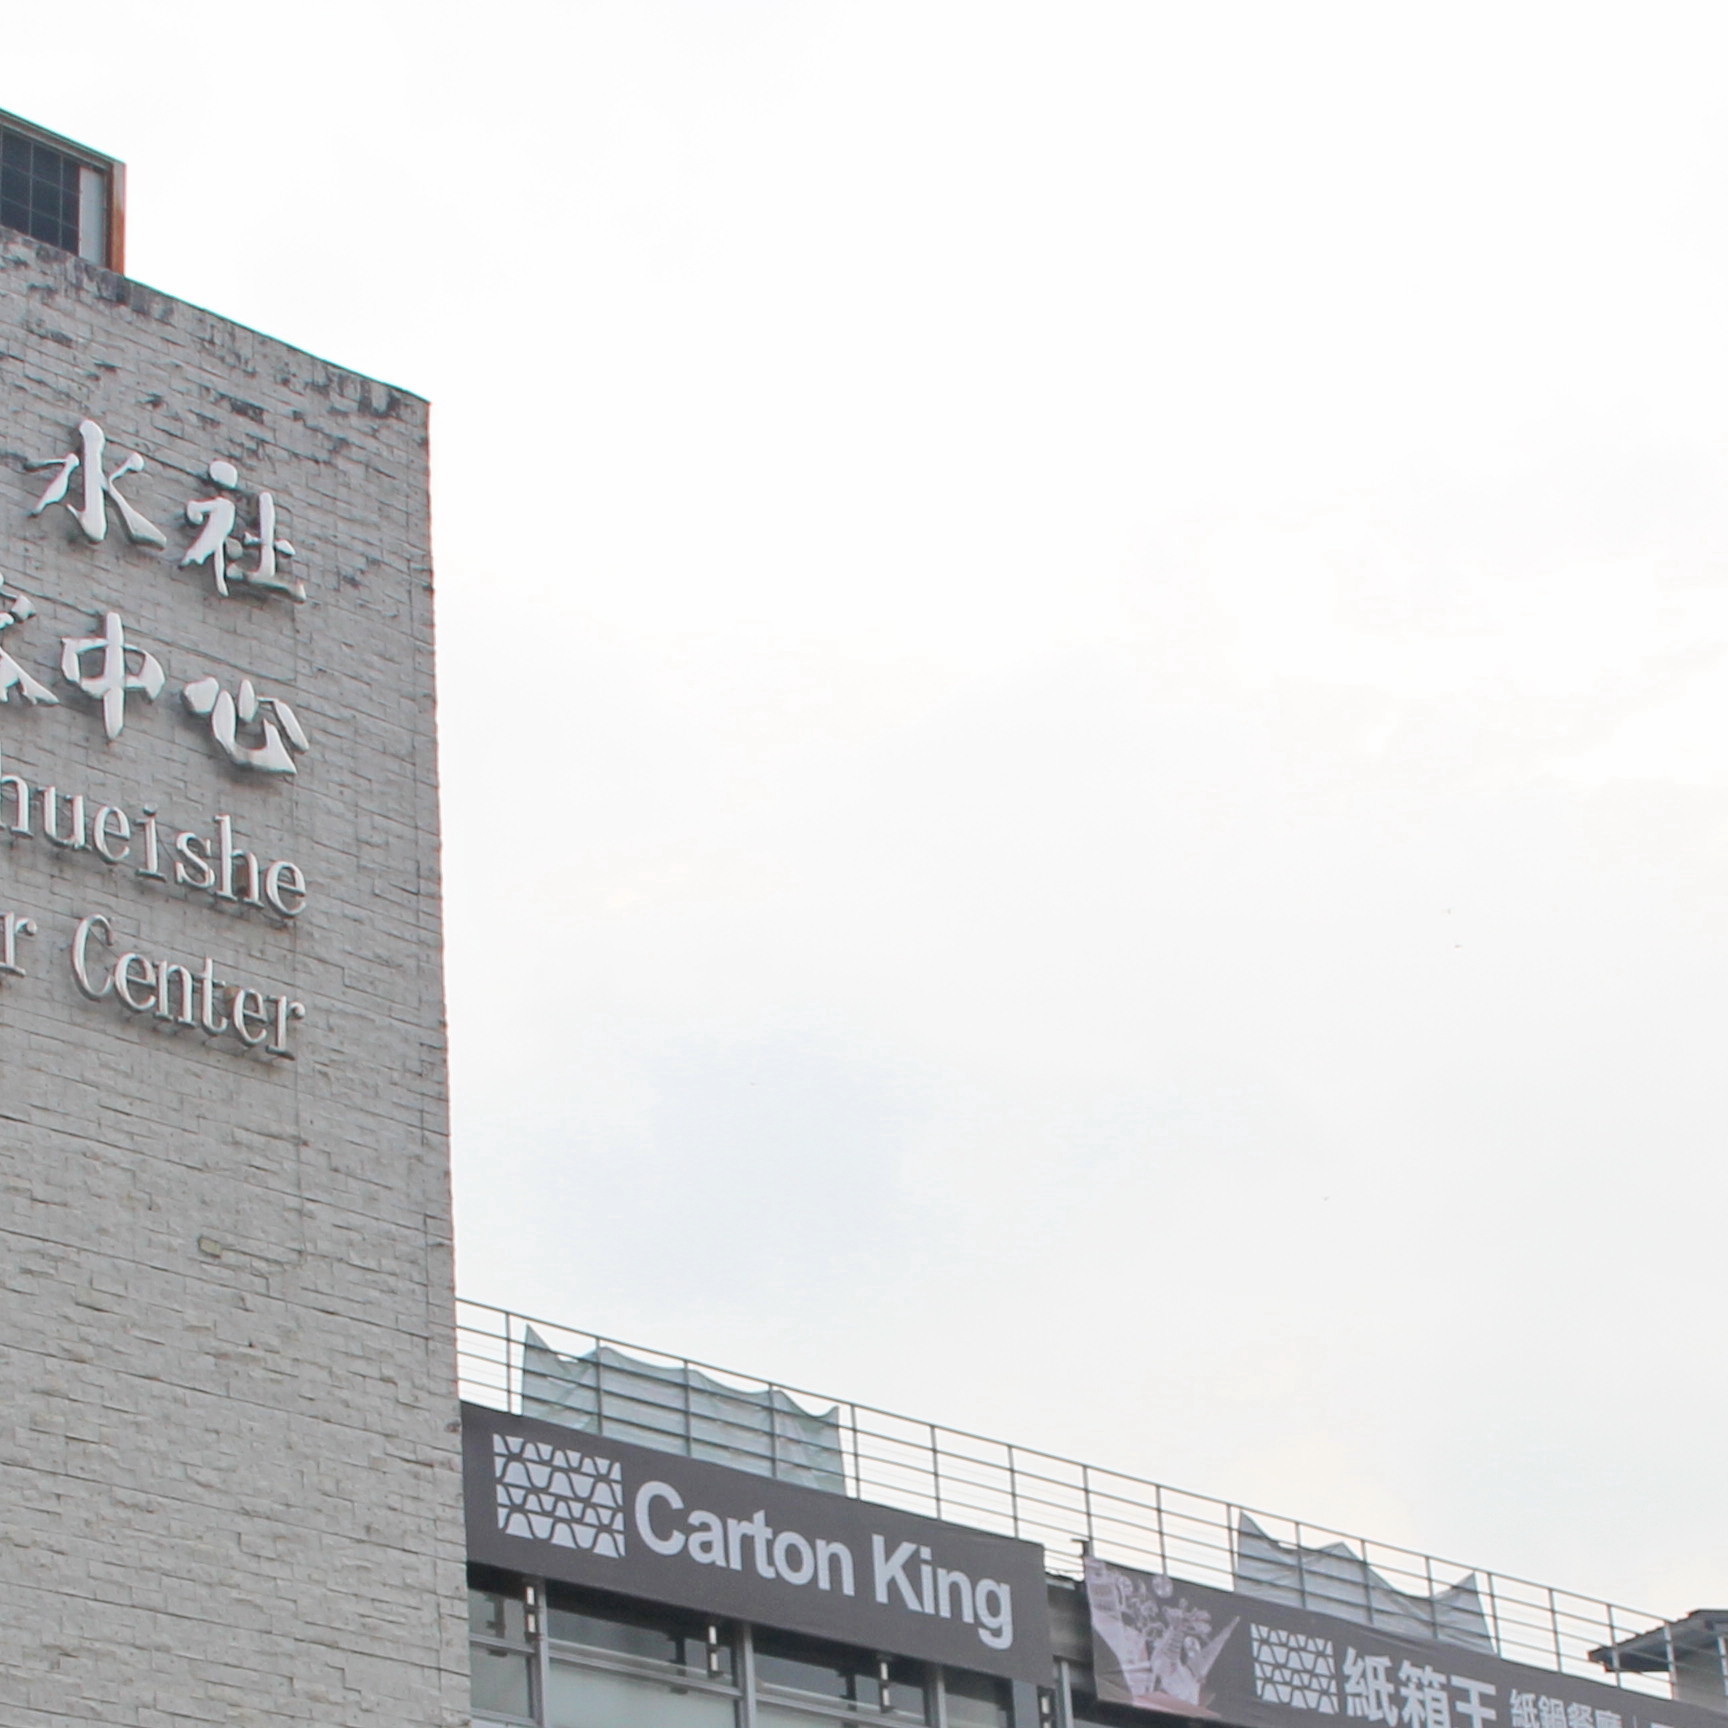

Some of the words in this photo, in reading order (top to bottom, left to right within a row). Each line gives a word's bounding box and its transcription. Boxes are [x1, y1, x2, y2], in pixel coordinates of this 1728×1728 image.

[26, 419, 306, 602] 水社
[72, 913, 306, 1060] Center
[634, 1480, 855, 1598] Carton
[872, 1533, 1014, 1651] King
